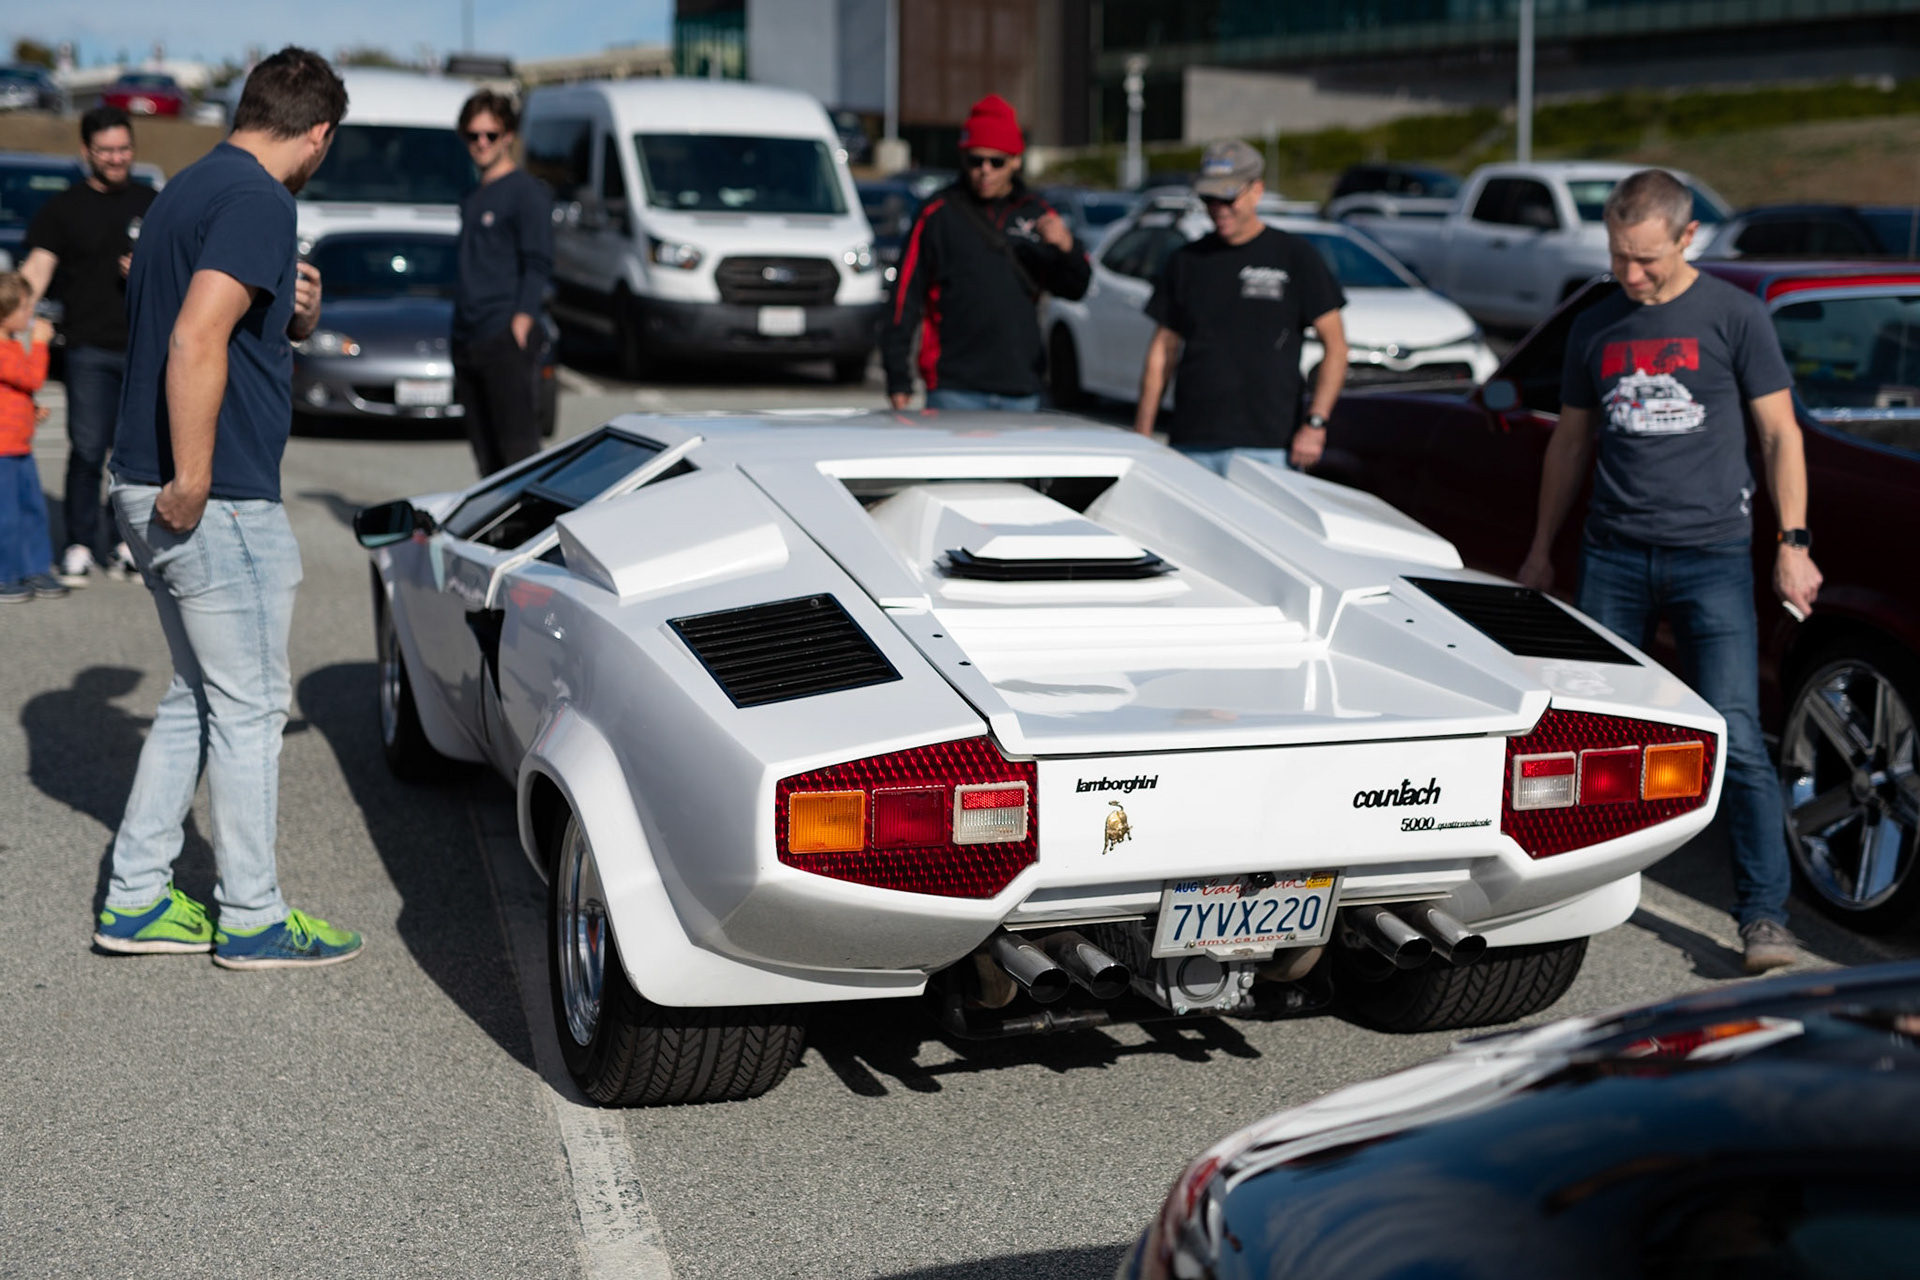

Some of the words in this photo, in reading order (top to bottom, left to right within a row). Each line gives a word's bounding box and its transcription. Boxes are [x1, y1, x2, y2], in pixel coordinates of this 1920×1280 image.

[1076, 775, 1158, 793] lamborghini
[1353, 777, 1441, 808] countach
[1400, 817, 1435, 831] 5000
[1175, 881, 1197, 893] AUG
[1173, 895, 1321, 941] 7YVX220
[1197, 934, 1284, 946] dmv.ca.gov
